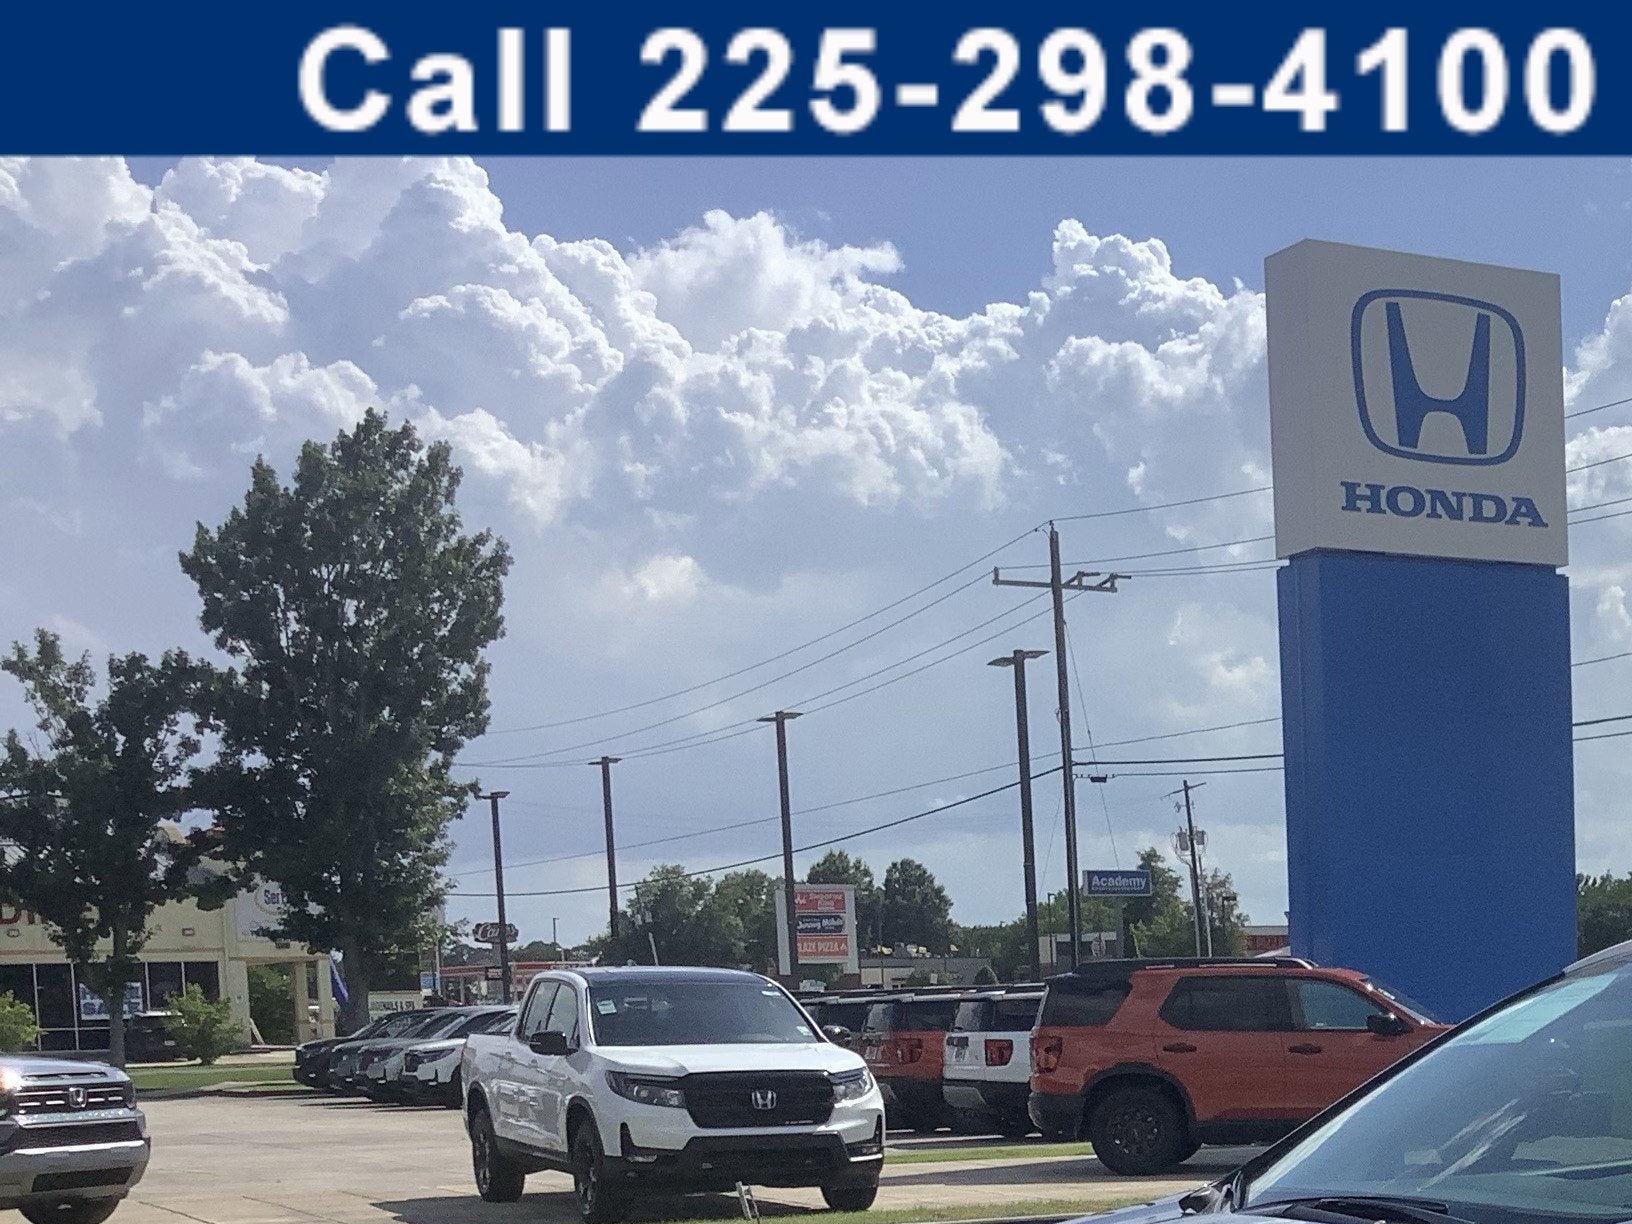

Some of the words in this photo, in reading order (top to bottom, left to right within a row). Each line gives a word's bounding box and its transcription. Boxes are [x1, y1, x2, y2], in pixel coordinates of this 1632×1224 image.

[1340, 481, 1549, 528] HONDA
[1092, 874, 1147, 890] Academy
[817, 941, 839, 952] PIZZA
